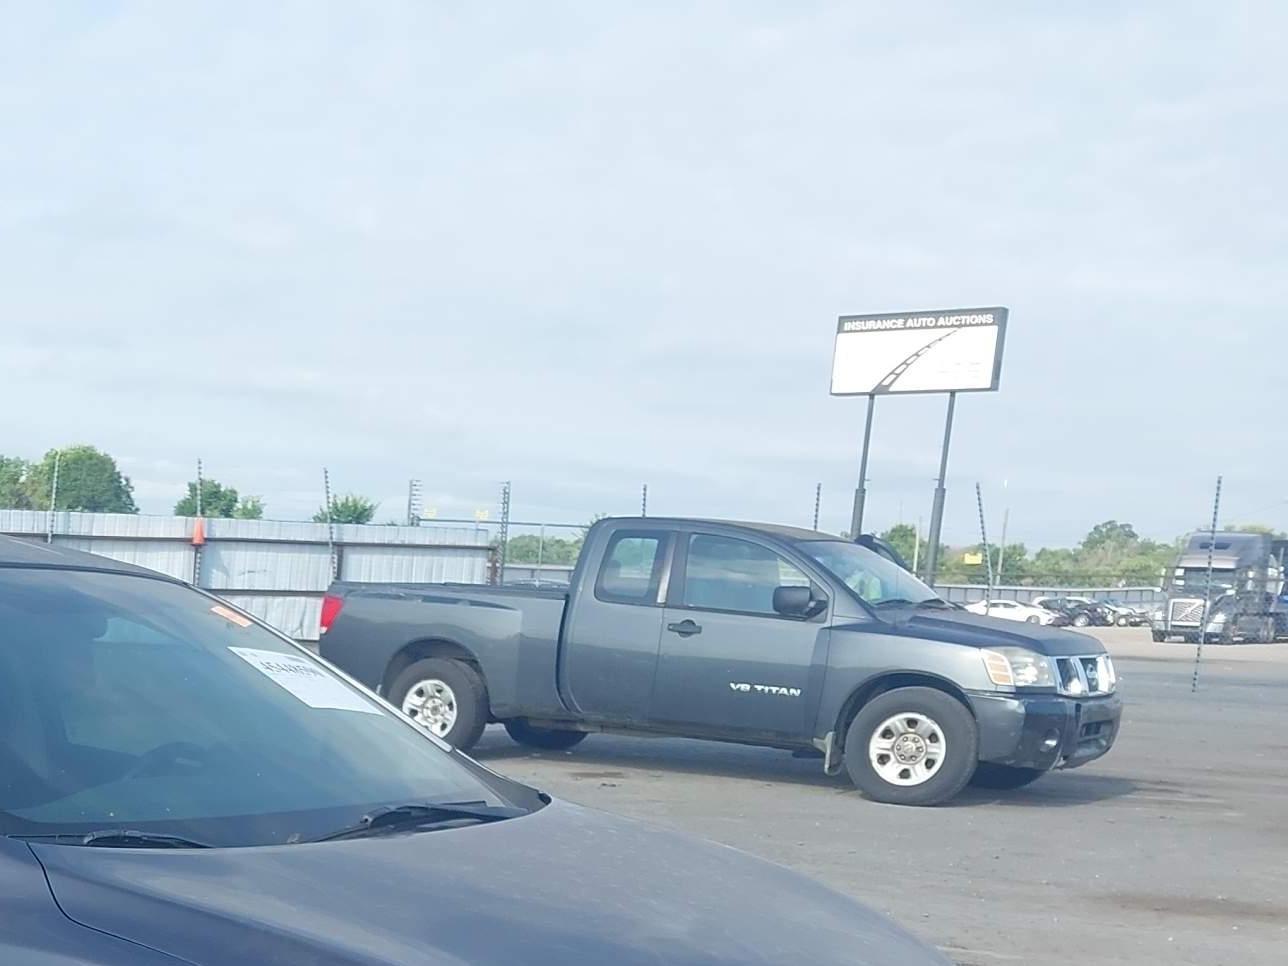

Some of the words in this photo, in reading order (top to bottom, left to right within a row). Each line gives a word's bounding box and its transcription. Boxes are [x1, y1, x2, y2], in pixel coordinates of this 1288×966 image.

[844, 319, 905, 331] INSURANCE
[906, 316, 935, 328] AUTO
[937, 314, 994, 326] AUCTIONS
[754, 684, 801, 696] TITAN
